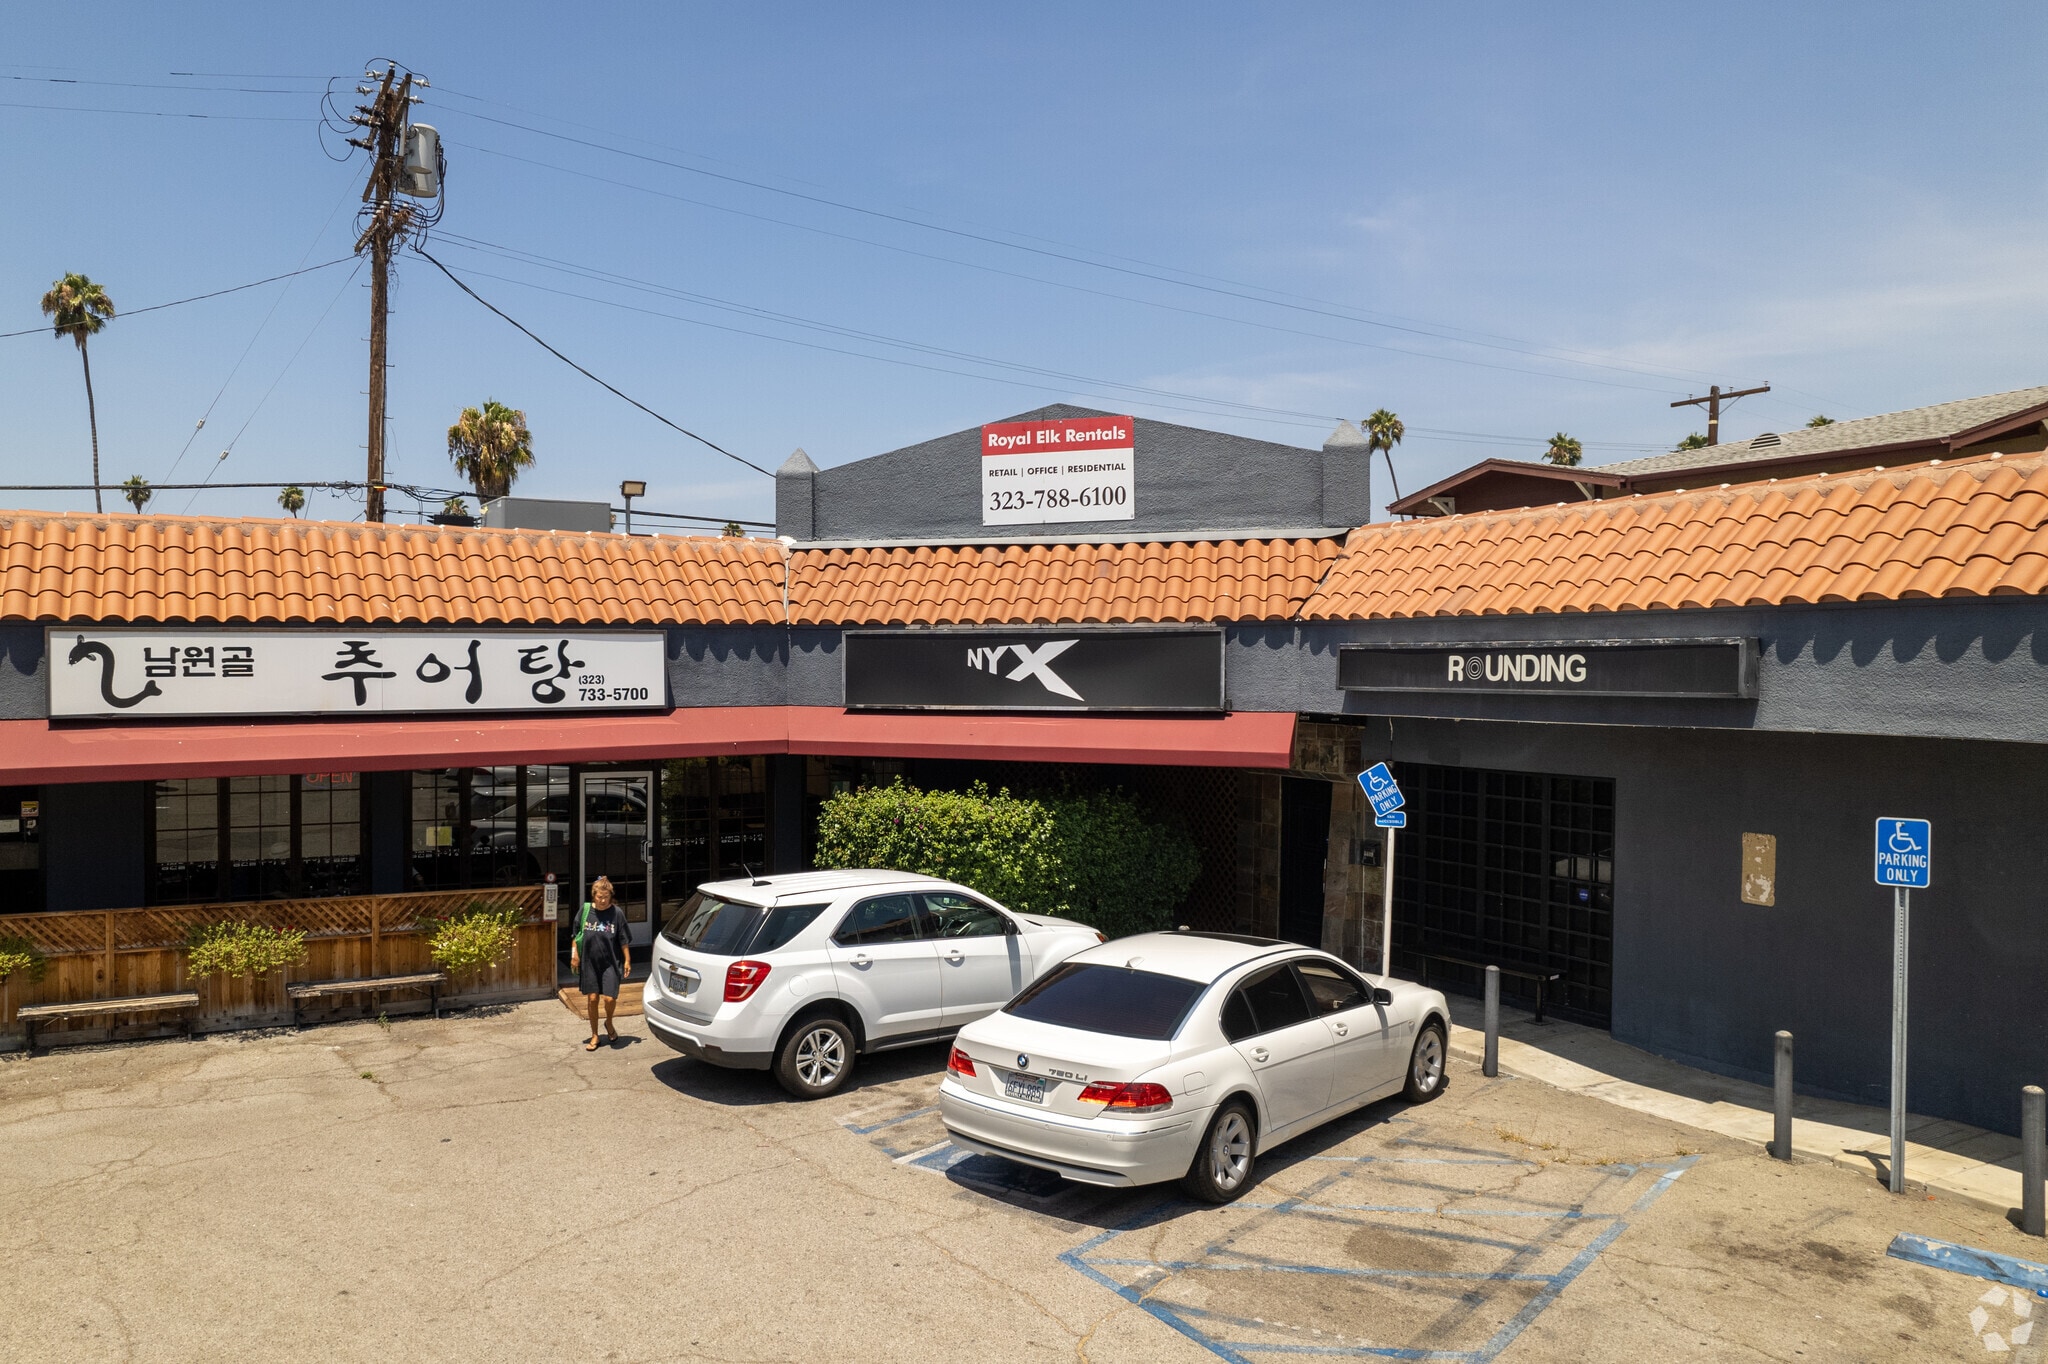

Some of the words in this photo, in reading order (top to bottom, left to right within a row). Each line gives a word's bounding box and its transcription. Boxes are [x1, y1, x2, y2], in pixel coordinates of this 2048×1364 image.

[988, 431, 1031, 449] Royal
[1036, 429, 1061, 445] Elk
[1065, 426, 1126, 442] Rentals
[989, 468, 1018, 477] RETAIL
[1027, 466, 1058, 475] OFFICE
[1067, 463, 1126, 473] RESIDENTIAL
[989, 486, 1126, 511] 323-788-6100
[144, 646, 255, 678] 남원골
[967, 639, 1085, 702] NYX
[1448, 654, 1587, 683] ROUNDING
[321, 639, 586, 706] 추어탕
[578, 675, 605, 685] (323)
[578, 687, 649, 701] 733-5700
[306, 772, 353, 783] OPEN
[1371, 784, 1397, 804] PARKING
[1380, 796, 1397, 811] ONLY
[1879, 852, 1927, 868] PARKING
[1887, 868, 1918, 882] ONLY
